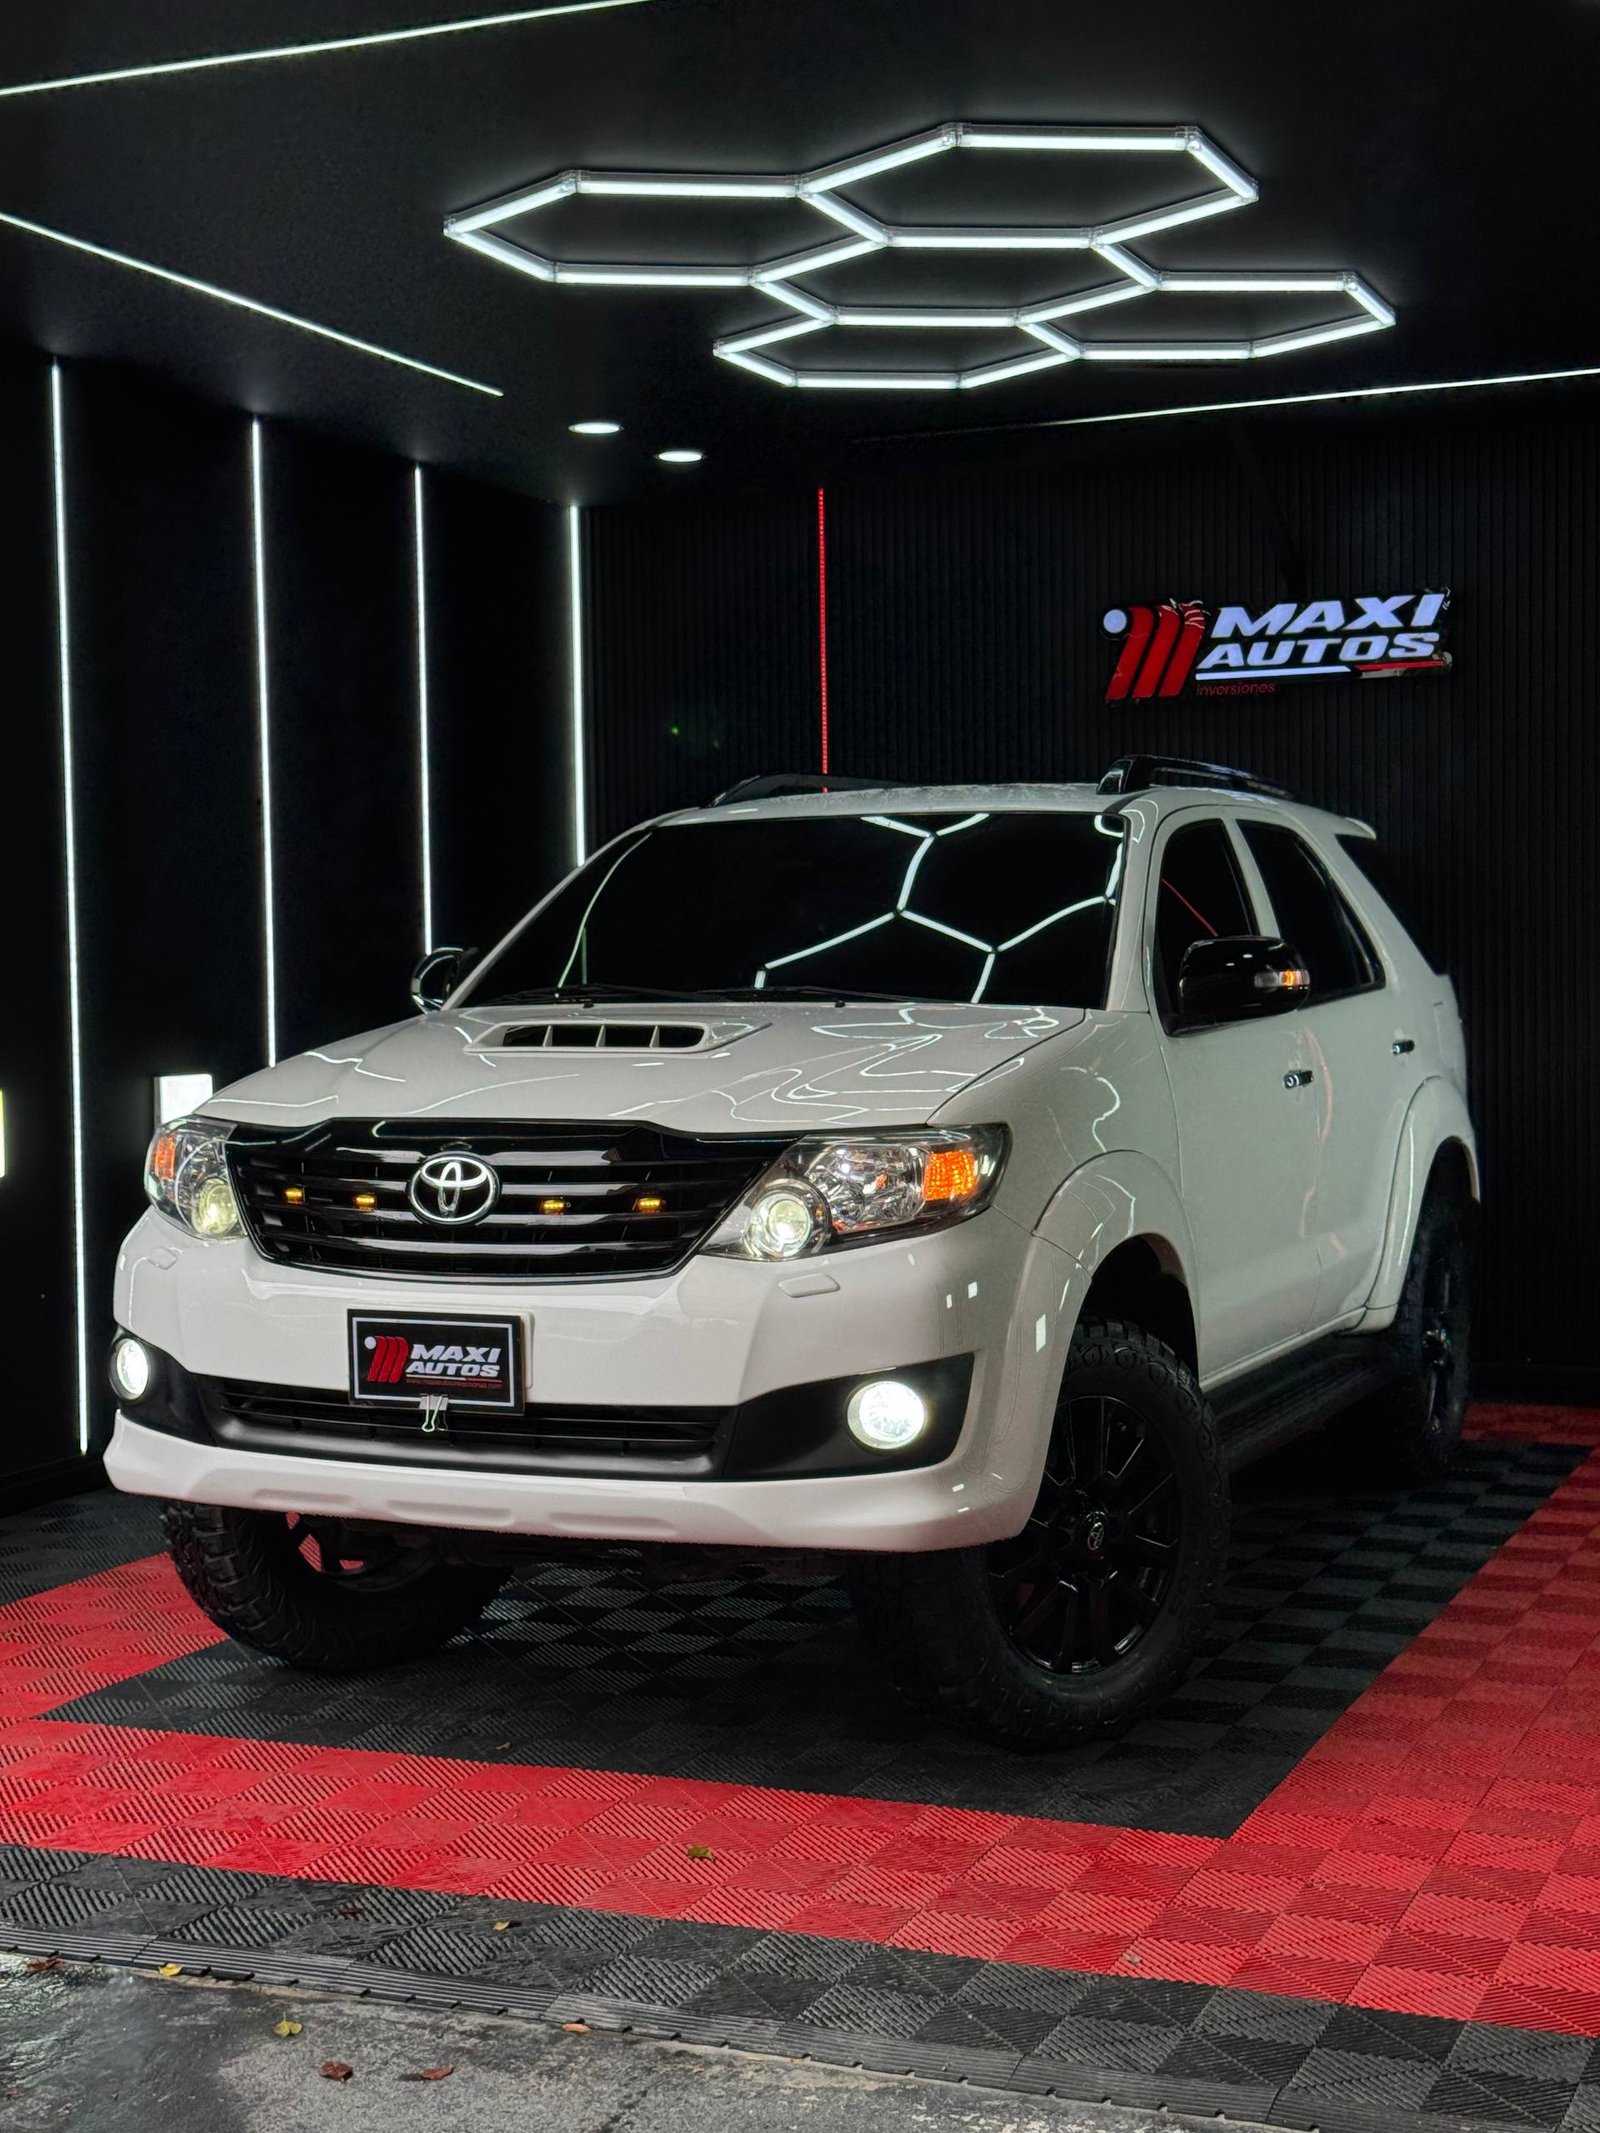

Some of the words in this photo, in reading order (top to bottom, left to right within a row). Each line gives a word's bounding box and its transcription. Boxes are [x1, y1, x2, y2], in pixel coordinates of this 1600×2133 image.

[1210, 593, 1445, 638] MAXI
[1195, 632, 1440, 669] AUTOS
[410, 1343, 501, 1363] MAXI
[405, 1361, 500, 1378] AUTOS
